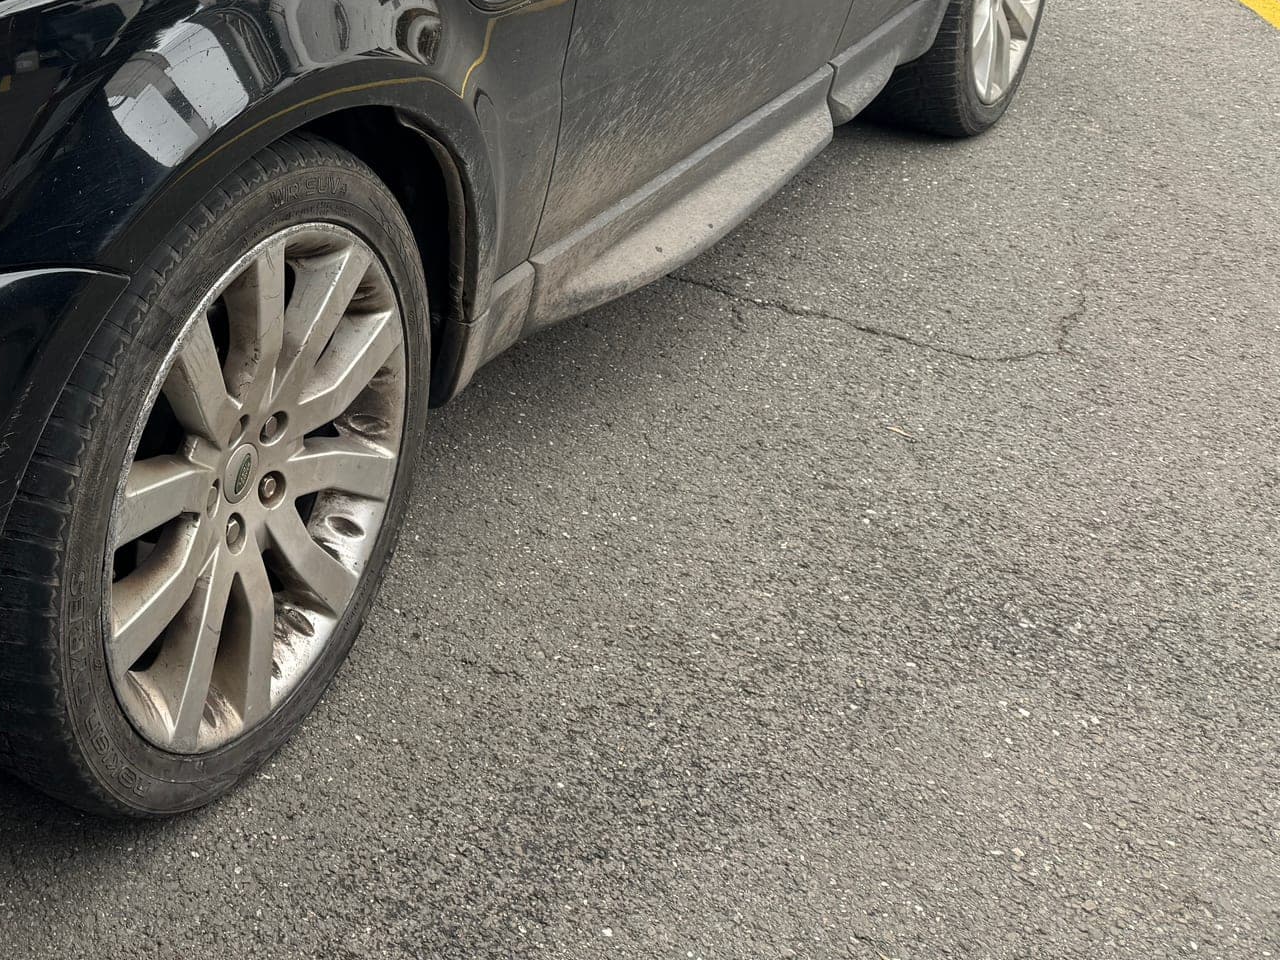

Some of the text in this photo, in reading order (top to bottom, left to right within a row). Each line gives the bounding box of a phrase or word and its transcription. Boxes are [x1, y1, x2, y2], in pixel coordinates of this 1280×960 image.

[270, 182, 300, 205] WR
[305, 175, 341, 196] SUV
[70, 571, 92, 707] TYRES
